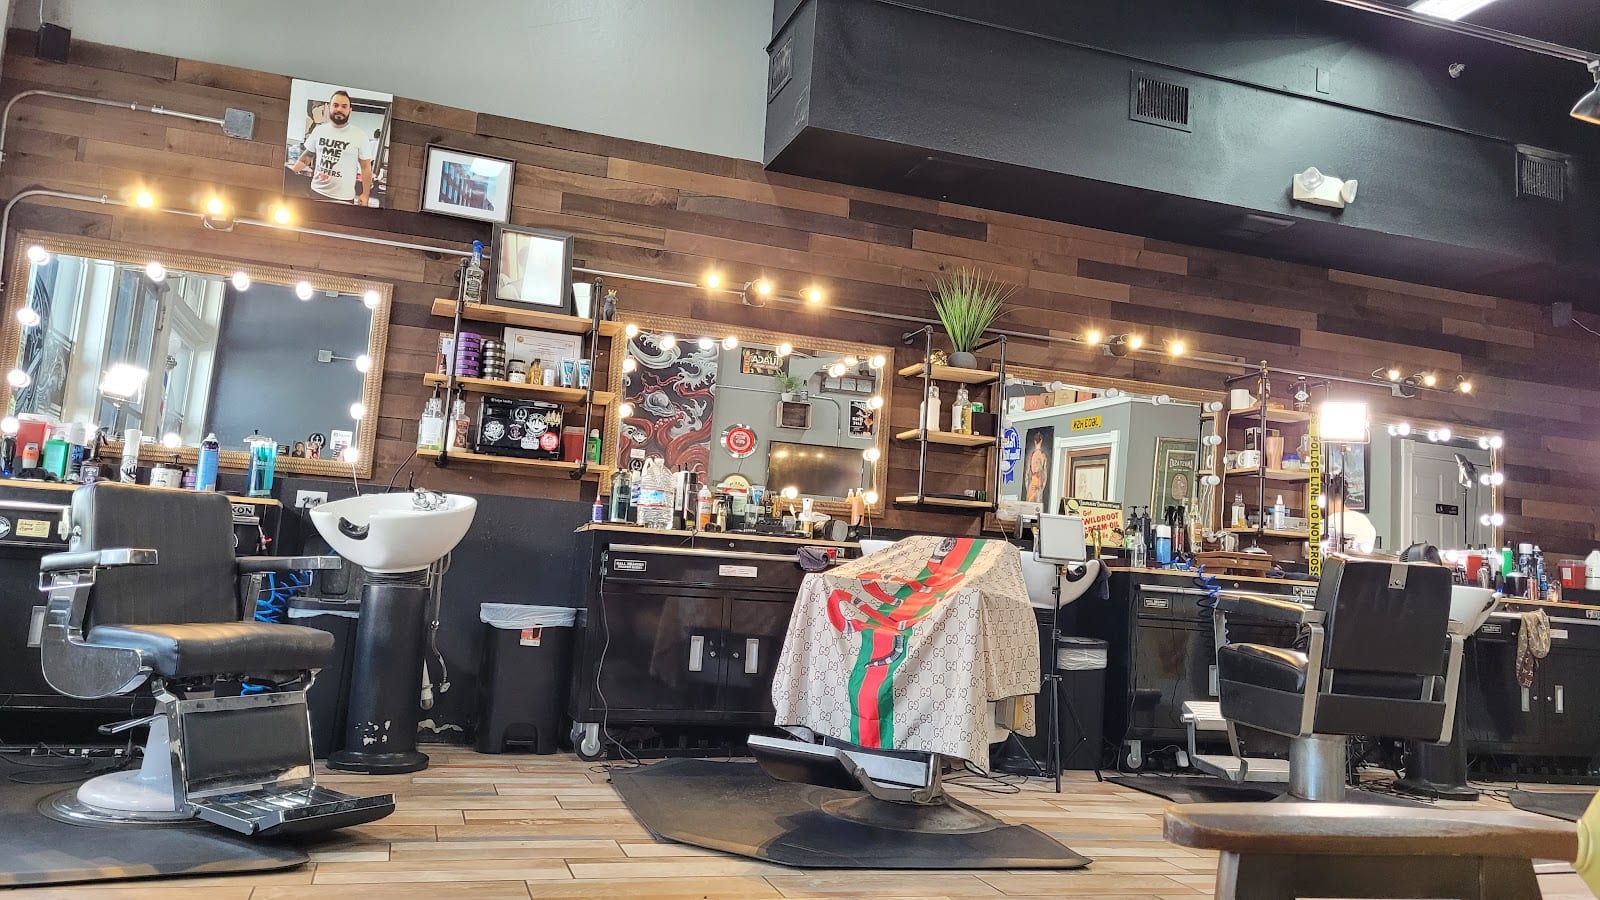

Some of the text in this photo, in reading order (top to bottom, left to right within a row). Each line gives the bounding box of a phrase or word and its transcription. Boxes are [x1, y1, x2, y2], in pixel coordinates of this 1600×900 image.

[319, 138, 350, 150] BURY
[322, 147, 342, 158] ME
[320, 159, 337, 169] MY
[1310, 436, 1319, 473] POLICE
[1310, 477, 1319, 500] LINE
[232, 506, 252, 514] KON
[1310, 506, 1319, 519] DO
[1310, 522, 1320, 544] NOT
